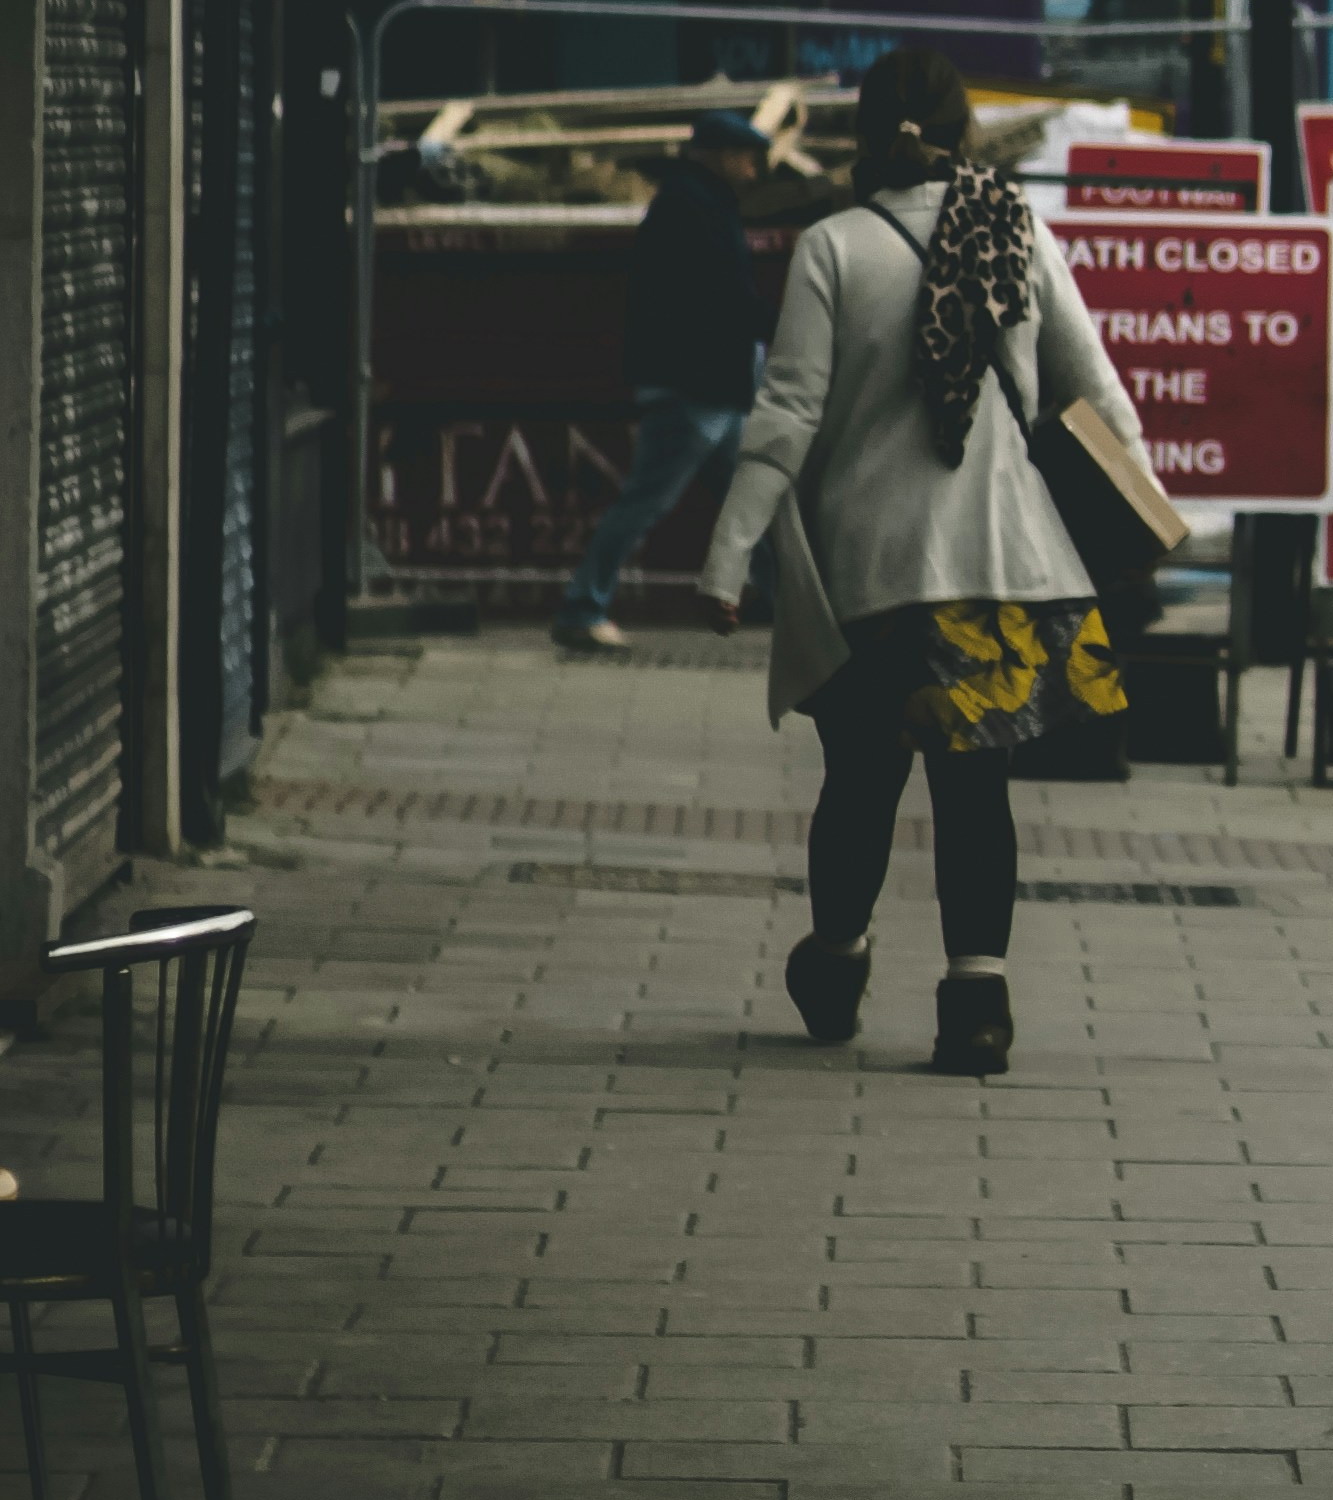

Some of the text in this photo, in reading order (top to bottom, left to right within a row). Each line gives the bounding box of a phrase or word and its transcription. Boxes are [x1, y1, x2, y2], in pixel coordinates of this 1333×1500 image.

[1153, 236, 1321, 275] CLOSED
[1241, 309, 1300, 347] TO
[1128, 366, 1208, 405] THE
